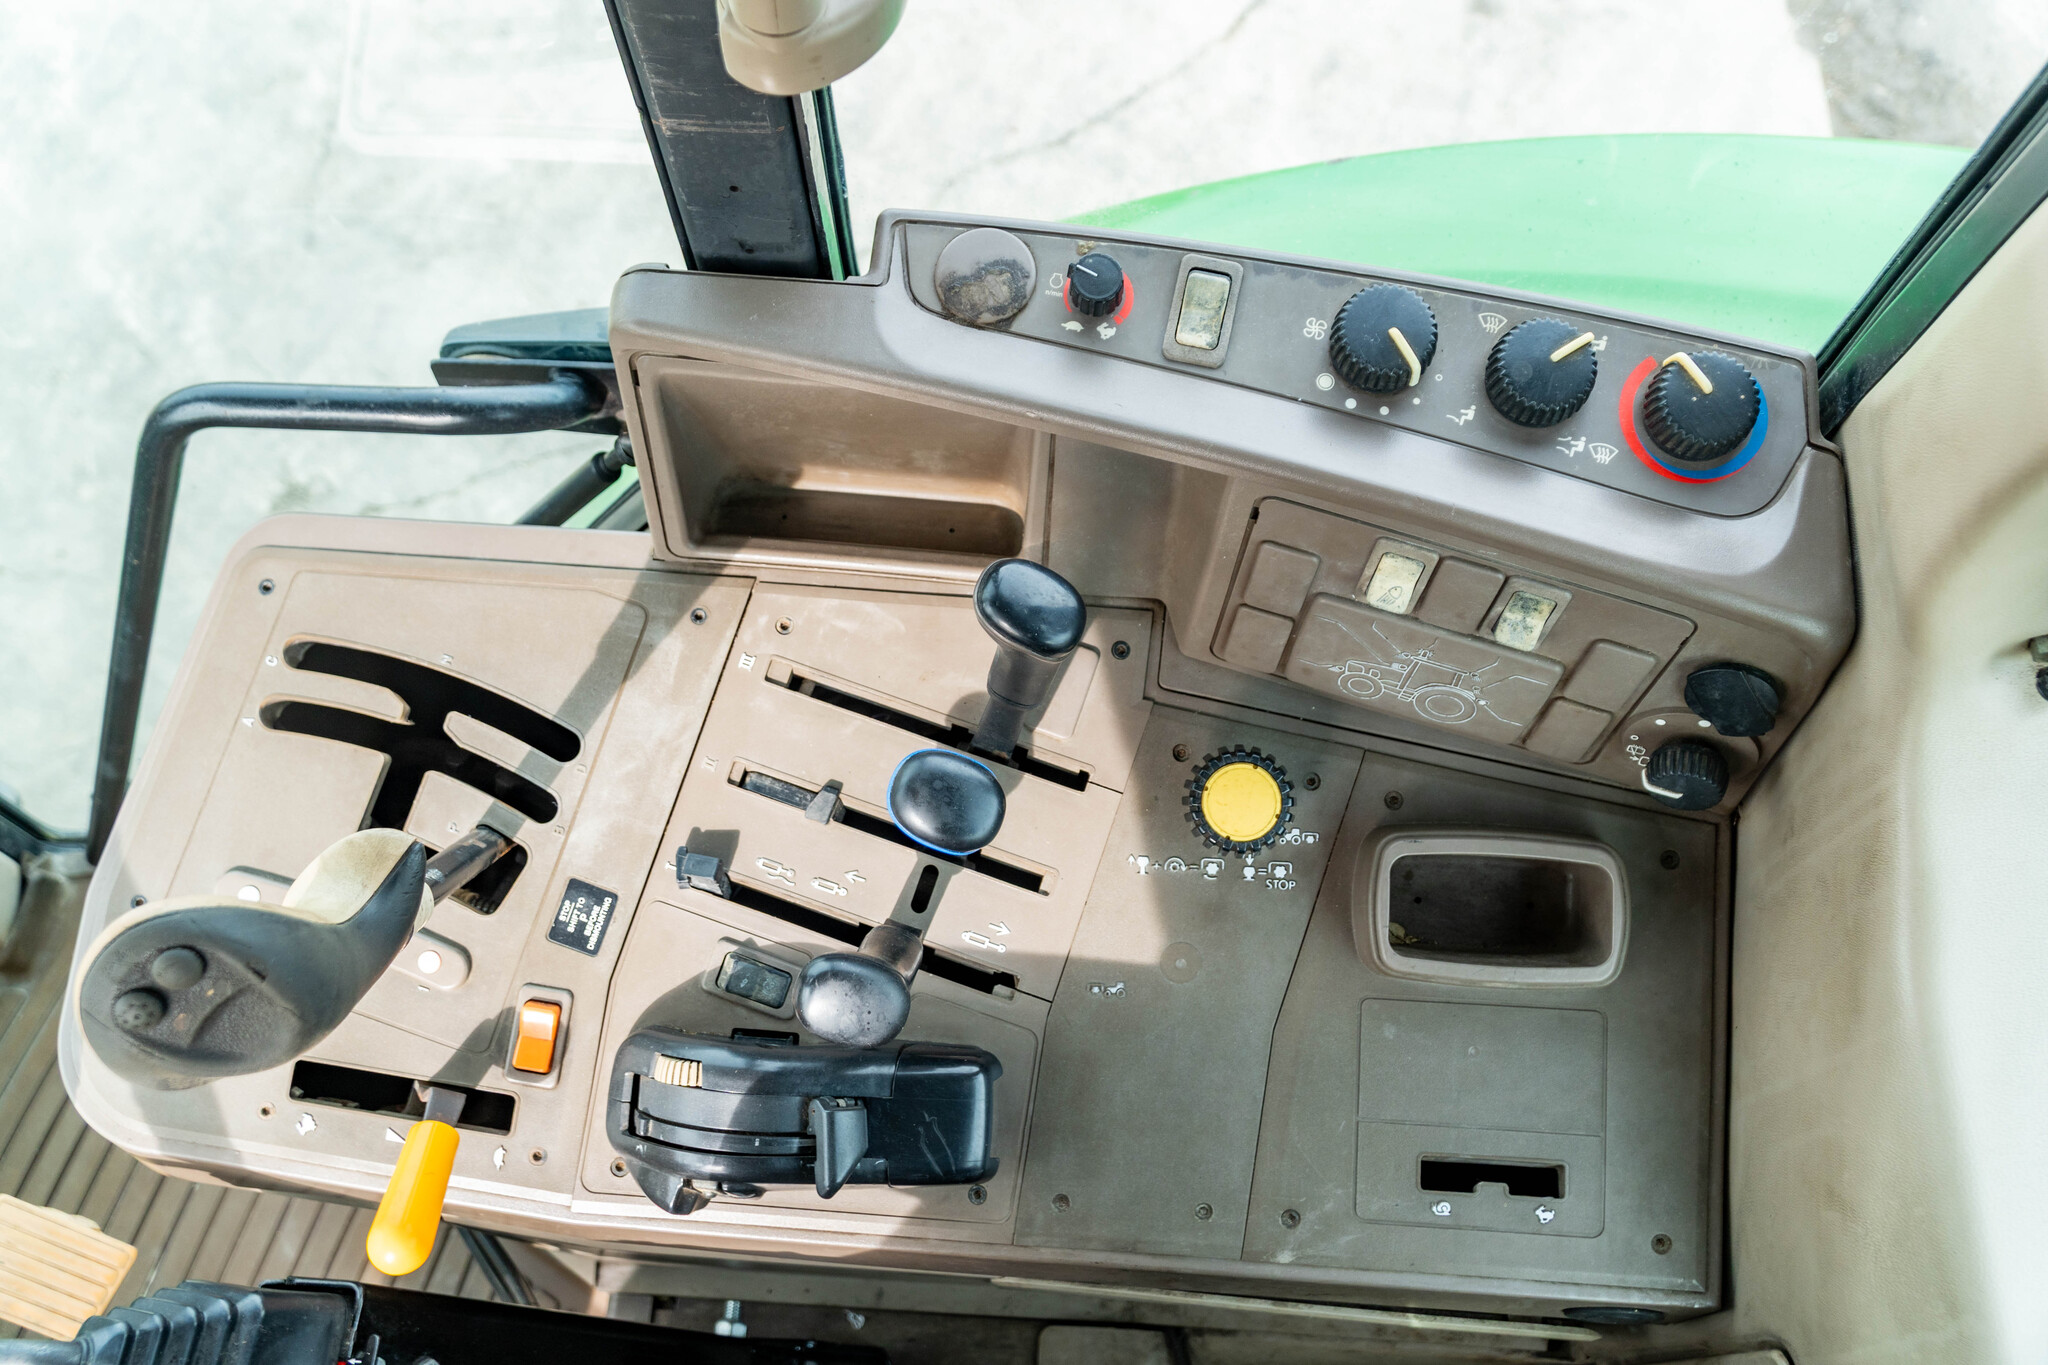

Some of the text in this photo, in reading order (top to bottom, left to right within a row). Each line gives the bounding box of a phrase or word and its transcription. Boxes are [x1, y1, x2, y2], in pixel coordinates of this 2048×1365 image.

[241, 718, 255, 727] A
[1265, 879, 1296, 890] STOP
[558, 900, 571, 921] STOP
[567, 897, 586, 933] SHIFT TO
[579, 913, 588, 923] P
[583, 905, 601, 936] BEFORE
[586, 897, 612, 950] DISMOUNTING
